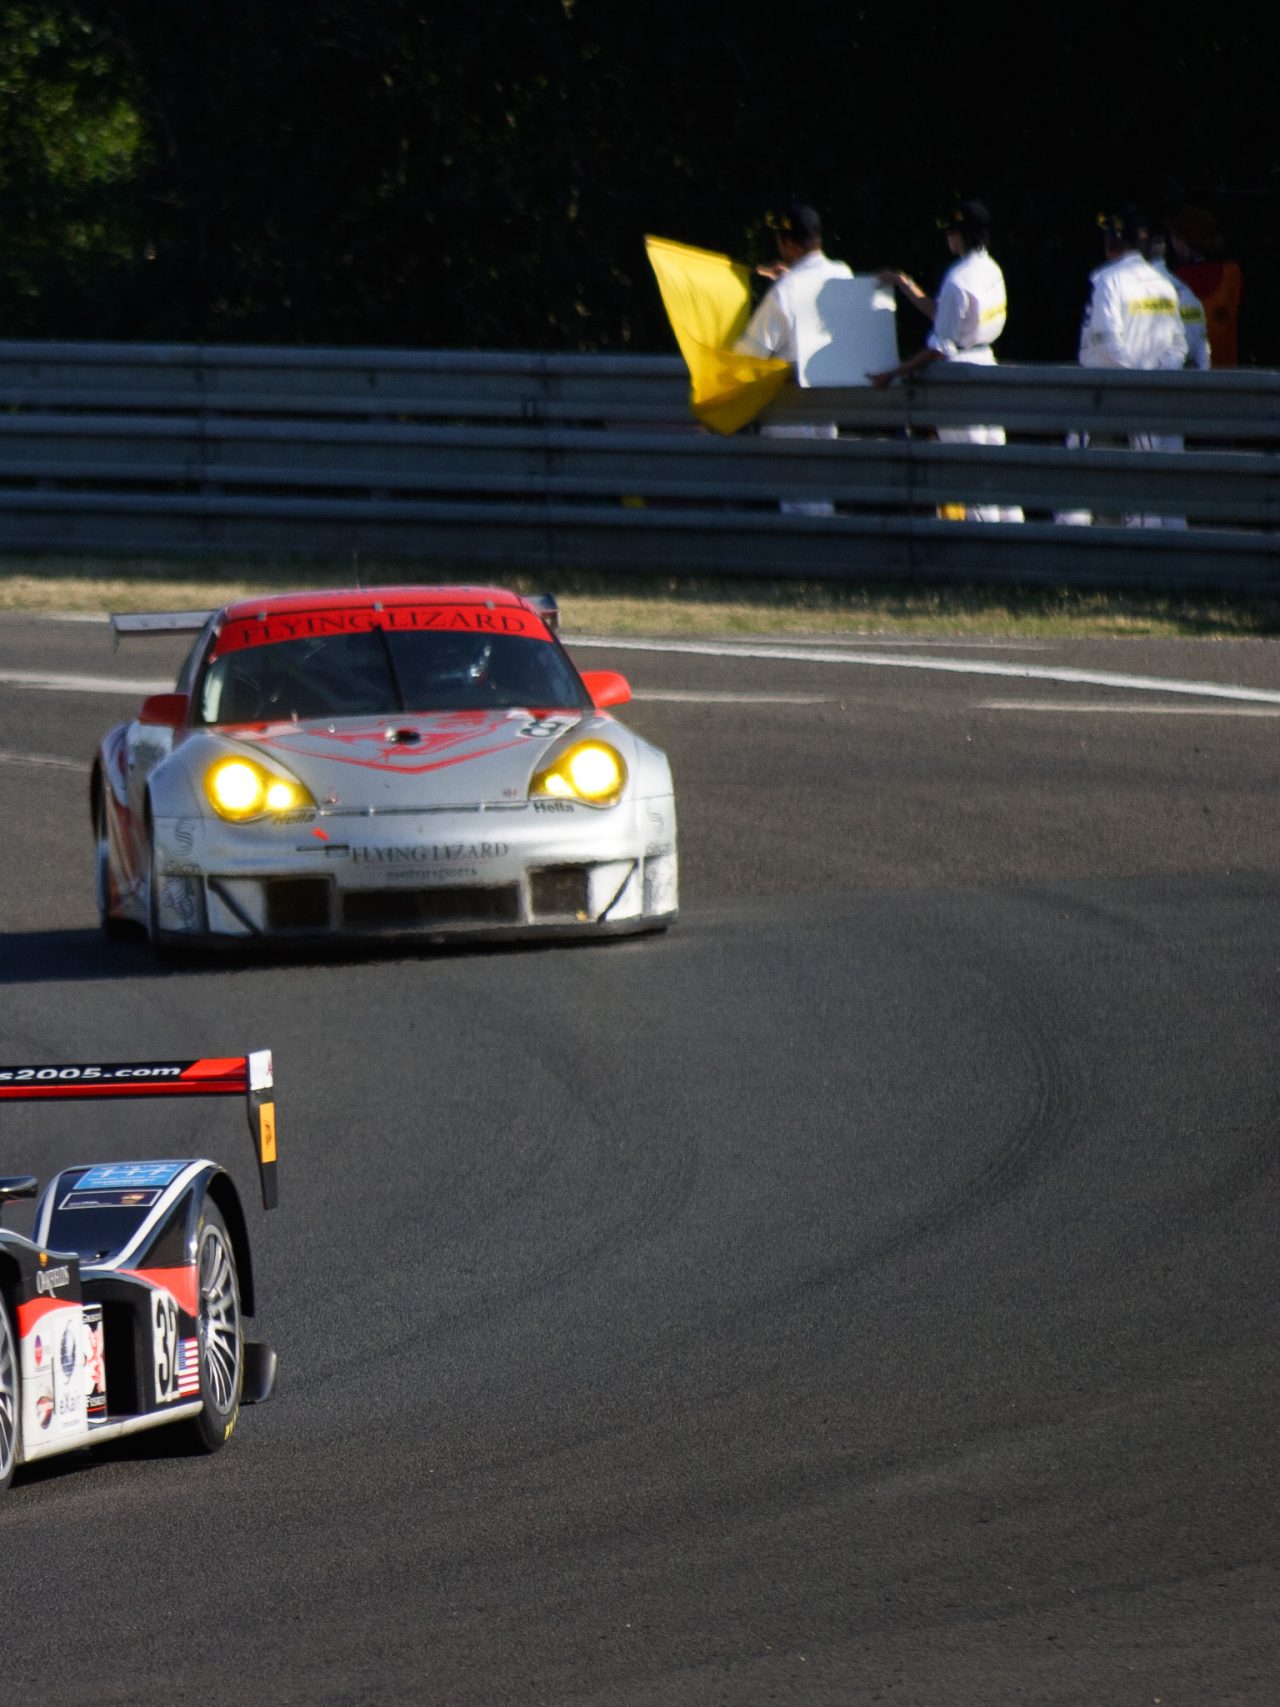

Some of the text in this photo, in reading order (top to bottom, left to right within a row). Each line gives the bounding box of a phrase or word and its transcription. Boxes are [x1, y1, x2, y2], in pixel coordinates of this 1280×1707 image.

[243, 612, 525, 643] FLYING LIZARD
[533, 800, 575, 814] Hella
[352, 842, 510, 864] FLYING LIZARD
[156, 1296, 179, 1397] 32
